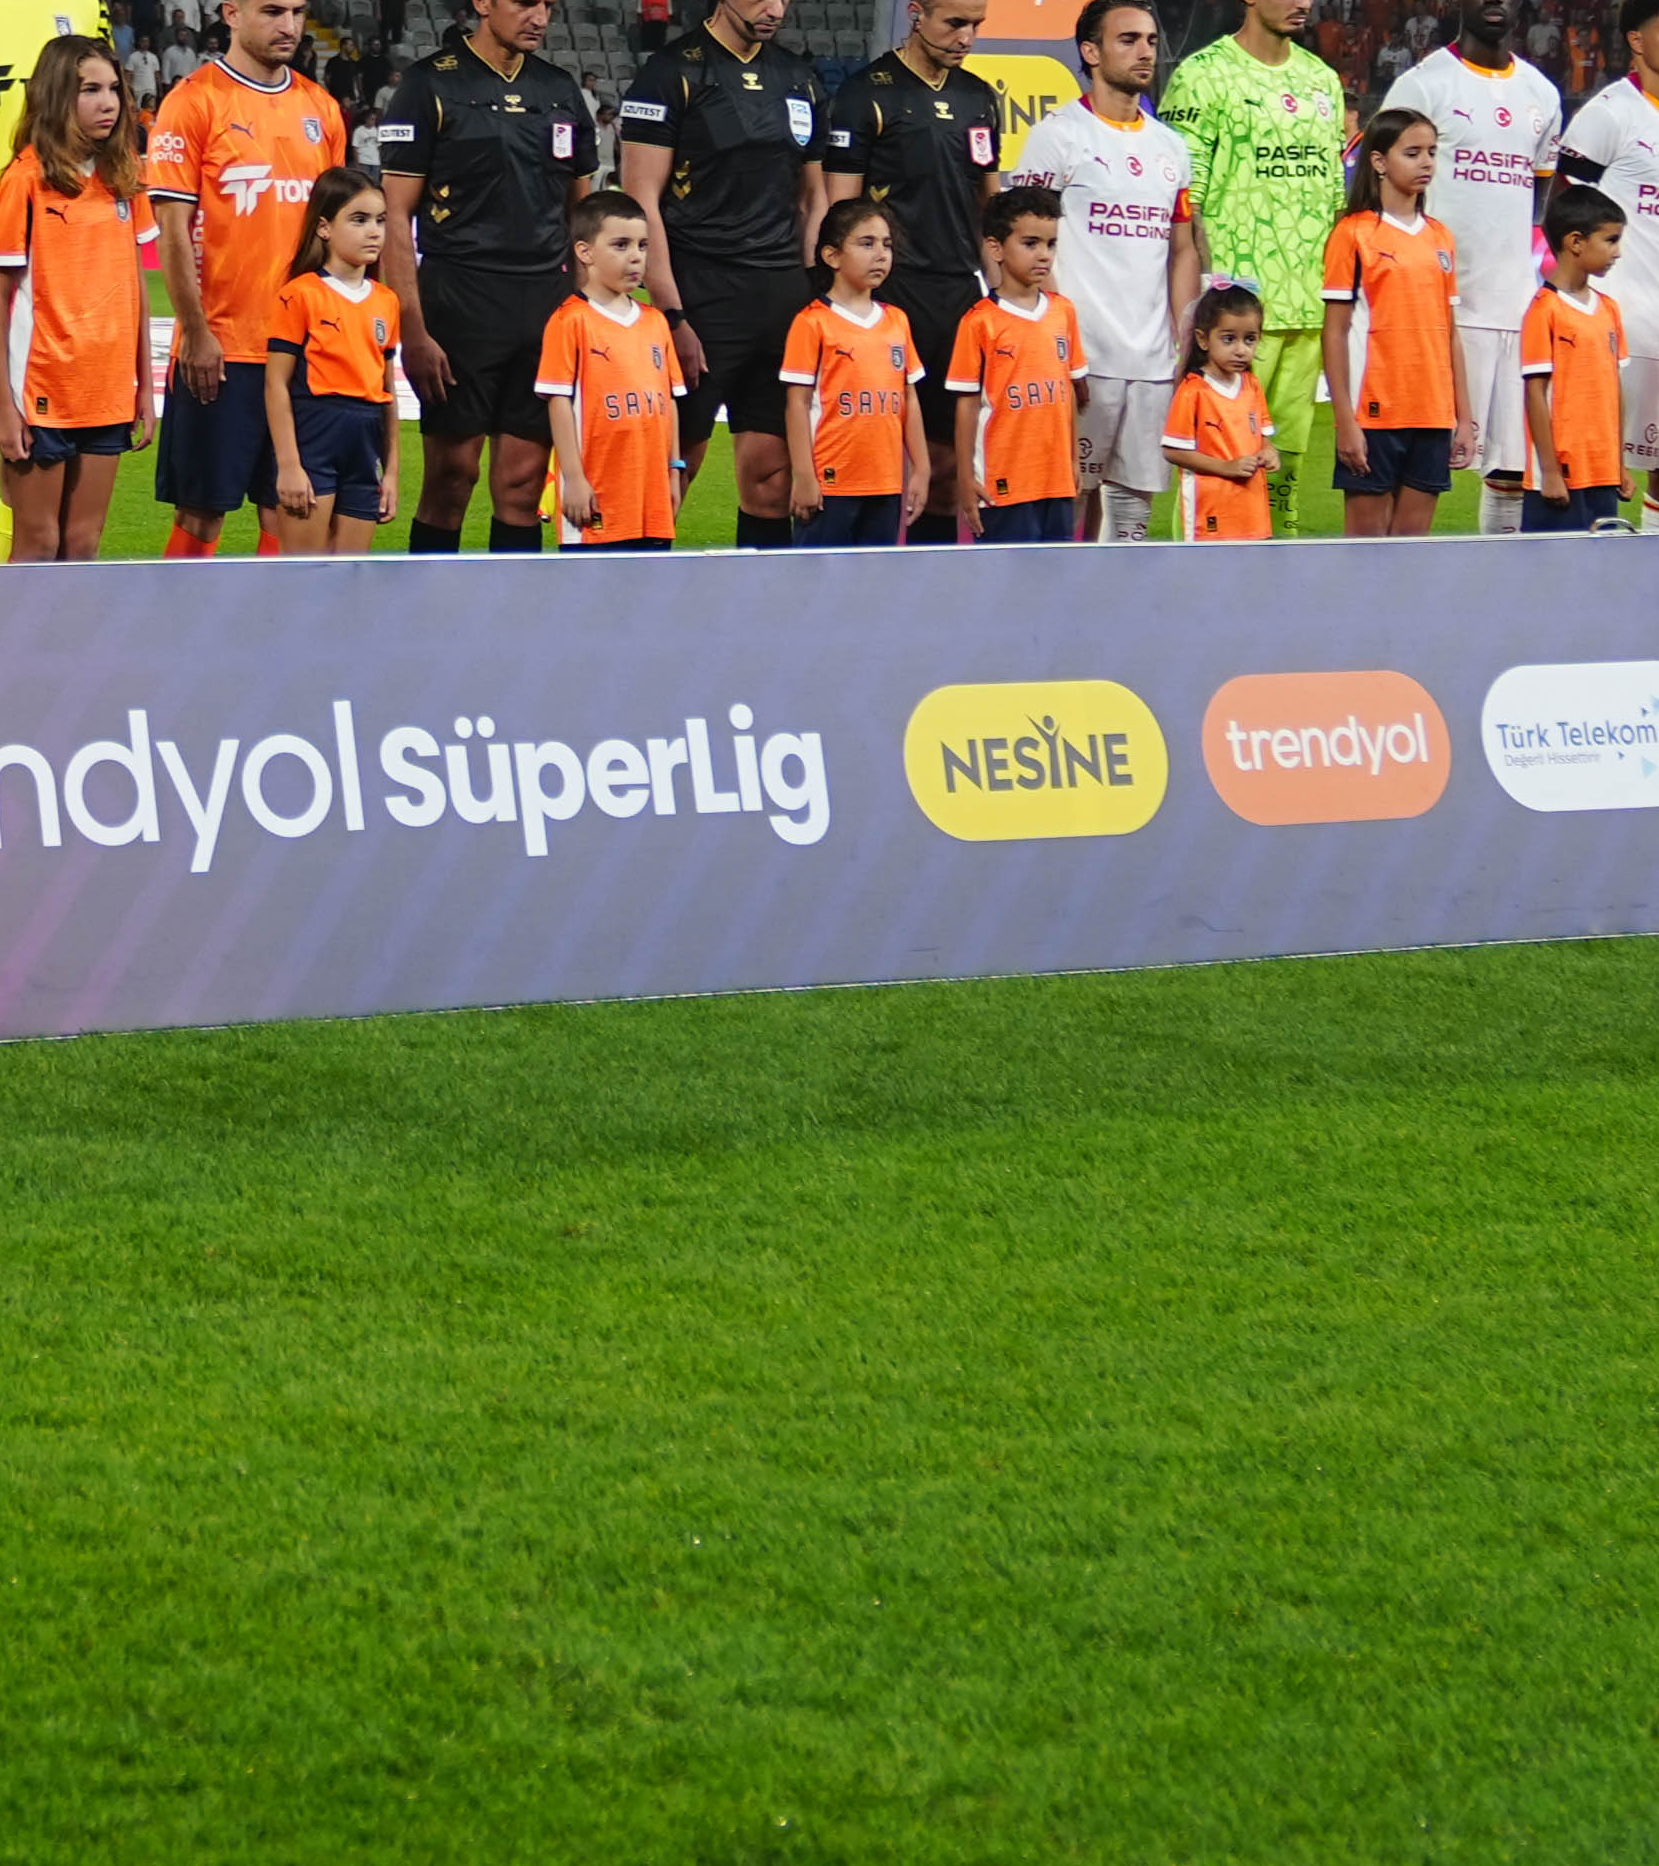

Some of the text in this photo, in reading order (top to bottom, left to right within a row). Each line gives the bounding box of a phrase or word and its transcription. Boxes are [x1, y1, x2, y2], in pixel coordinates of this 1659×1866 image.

[1226, 713, 1428, 775] trendyol
[1496, 720, 1659, 749] Türk Telekom
[380, 704, 829, 856] SüperLig
